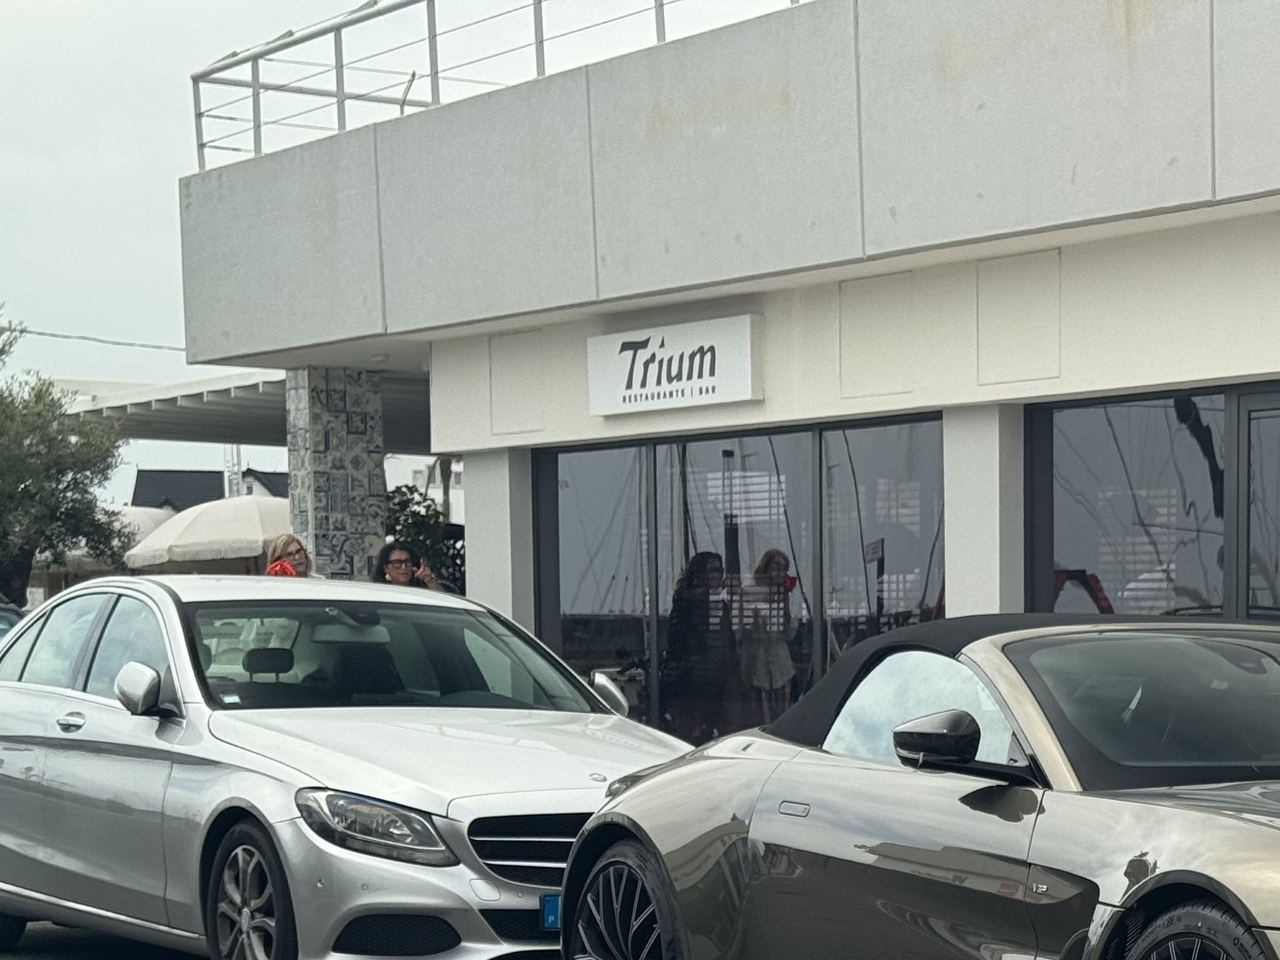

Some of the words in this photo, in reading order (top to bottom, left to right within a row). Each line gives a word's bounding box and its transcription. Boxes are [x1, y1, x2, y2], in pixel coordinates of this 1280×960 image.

[619, 336, 716, 390] Trium
[622, 388, 685, 404] RESTAURANTE
[699, 385, 716, 397] BAR
[548, 915, 555, 924] P
